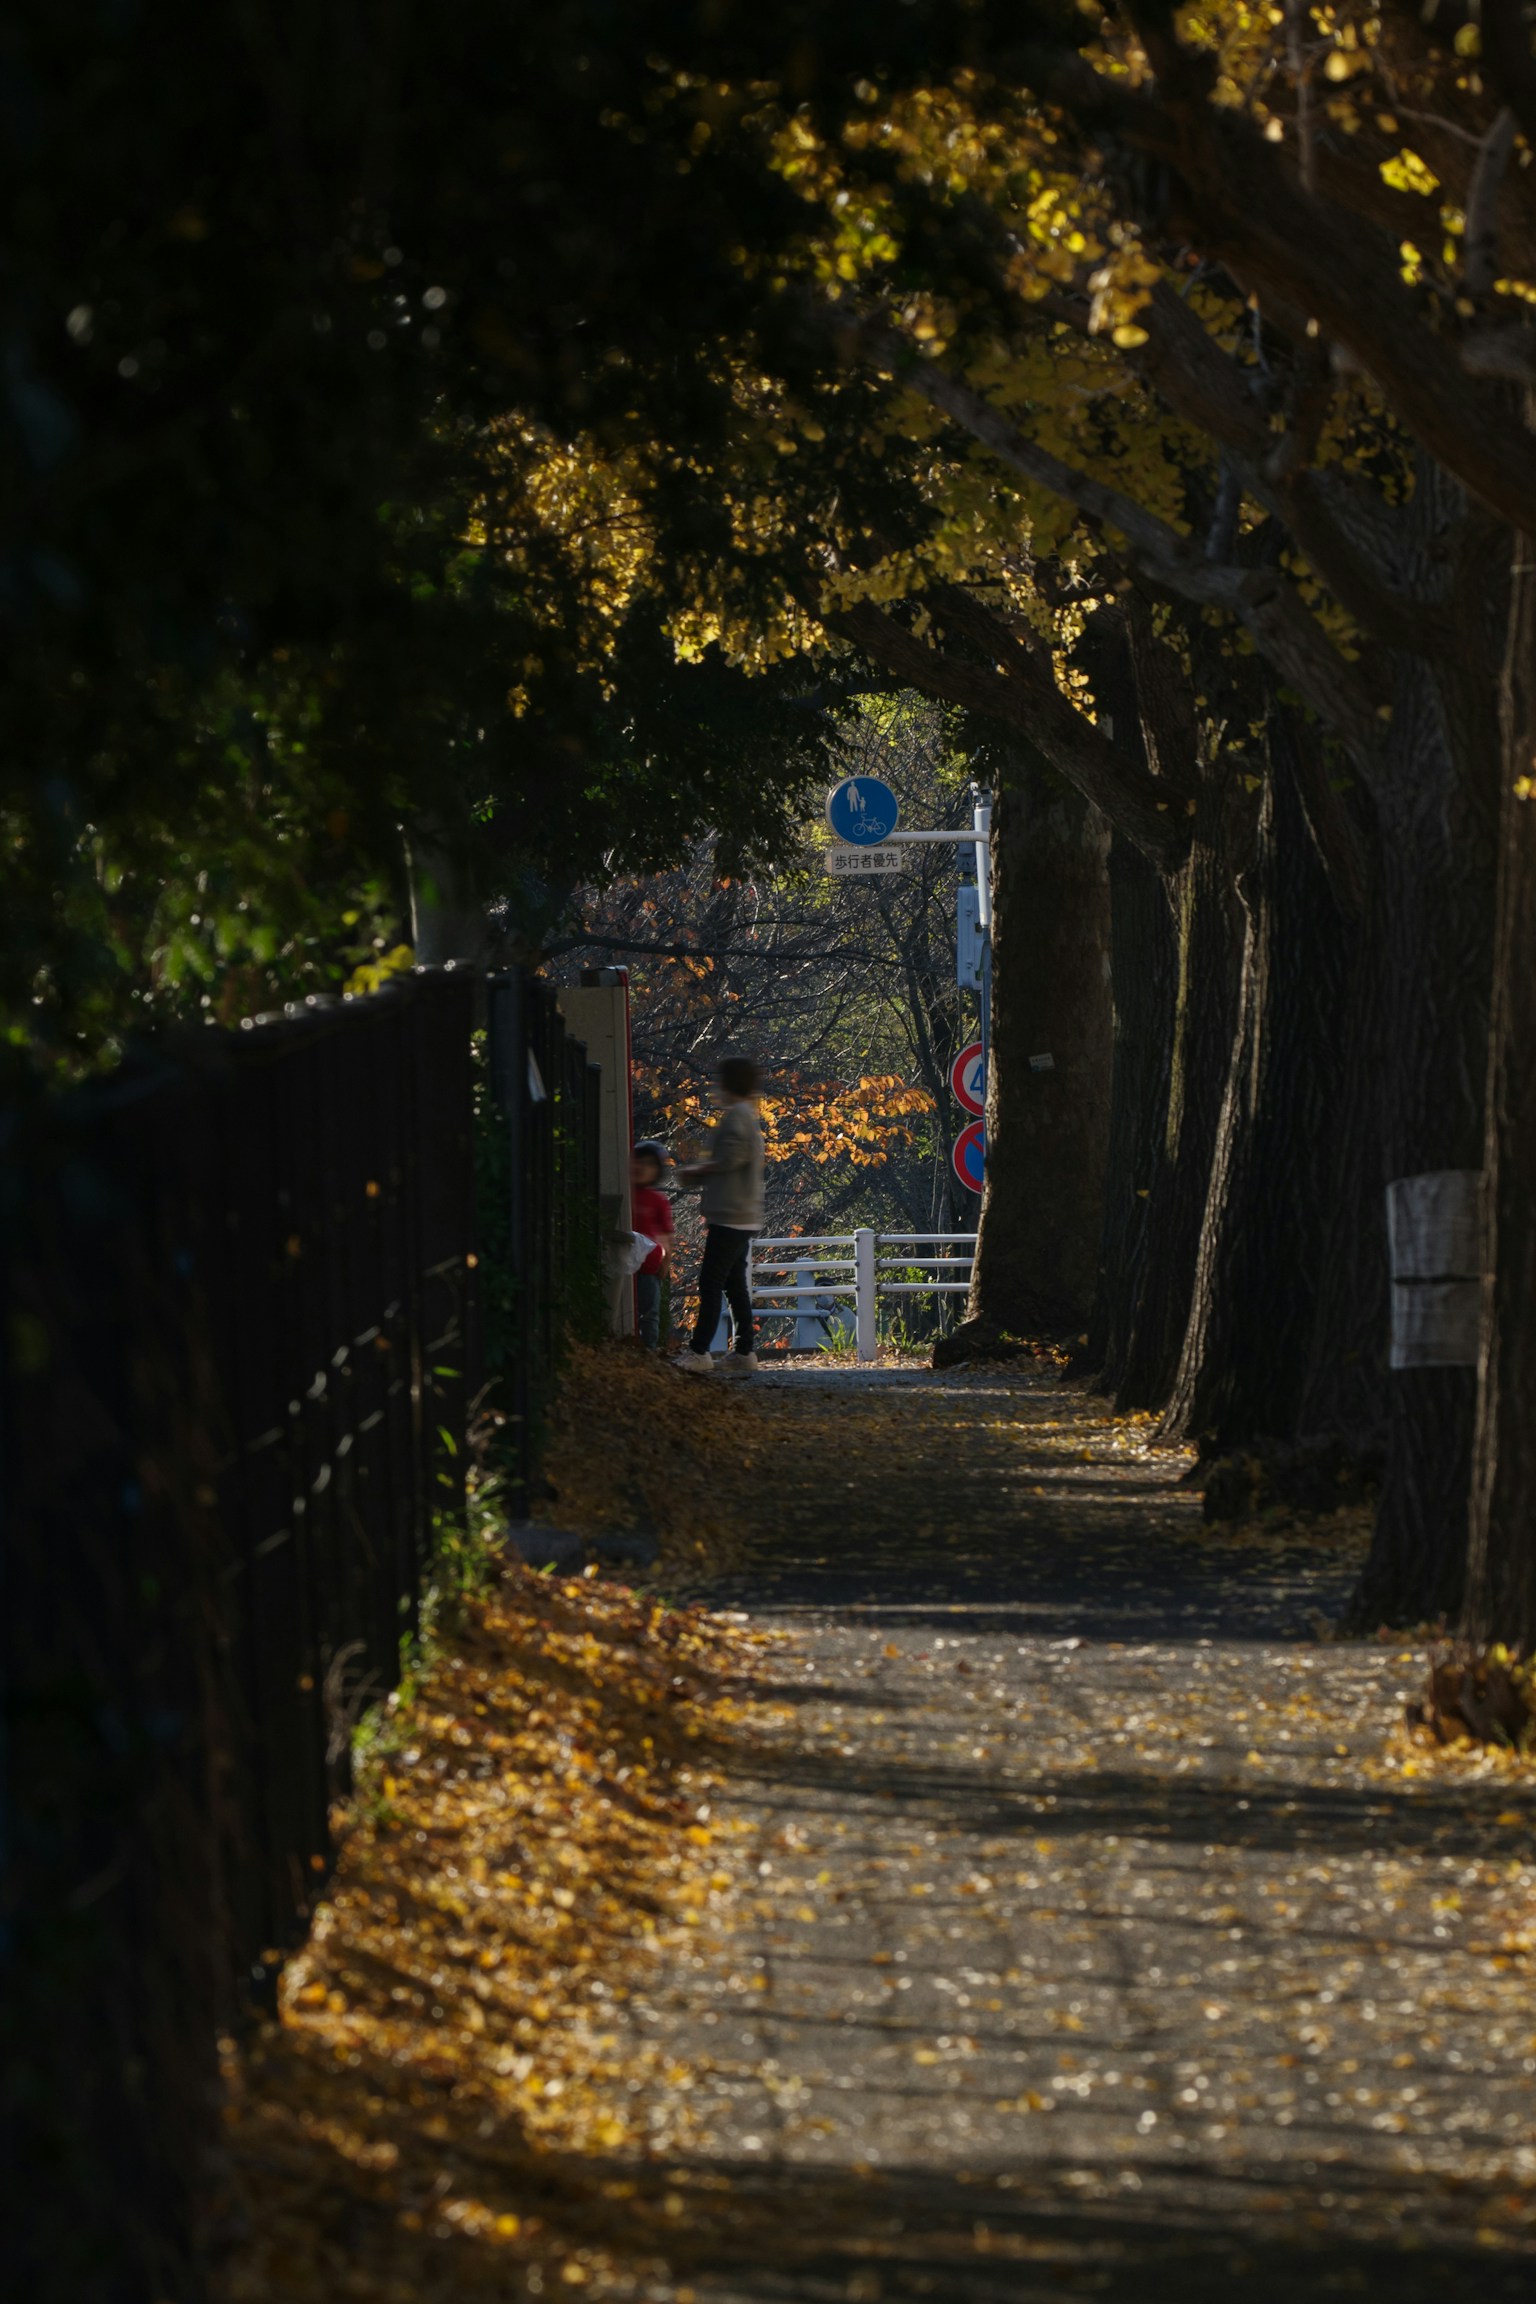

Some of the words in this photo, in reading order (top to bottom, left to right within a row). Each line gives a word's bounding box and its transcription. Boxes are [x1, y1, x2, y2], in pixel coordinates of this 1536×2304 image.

[835, 852, 899, 870] 歩行者優先
[970, 1063, 984, 1095] 4
